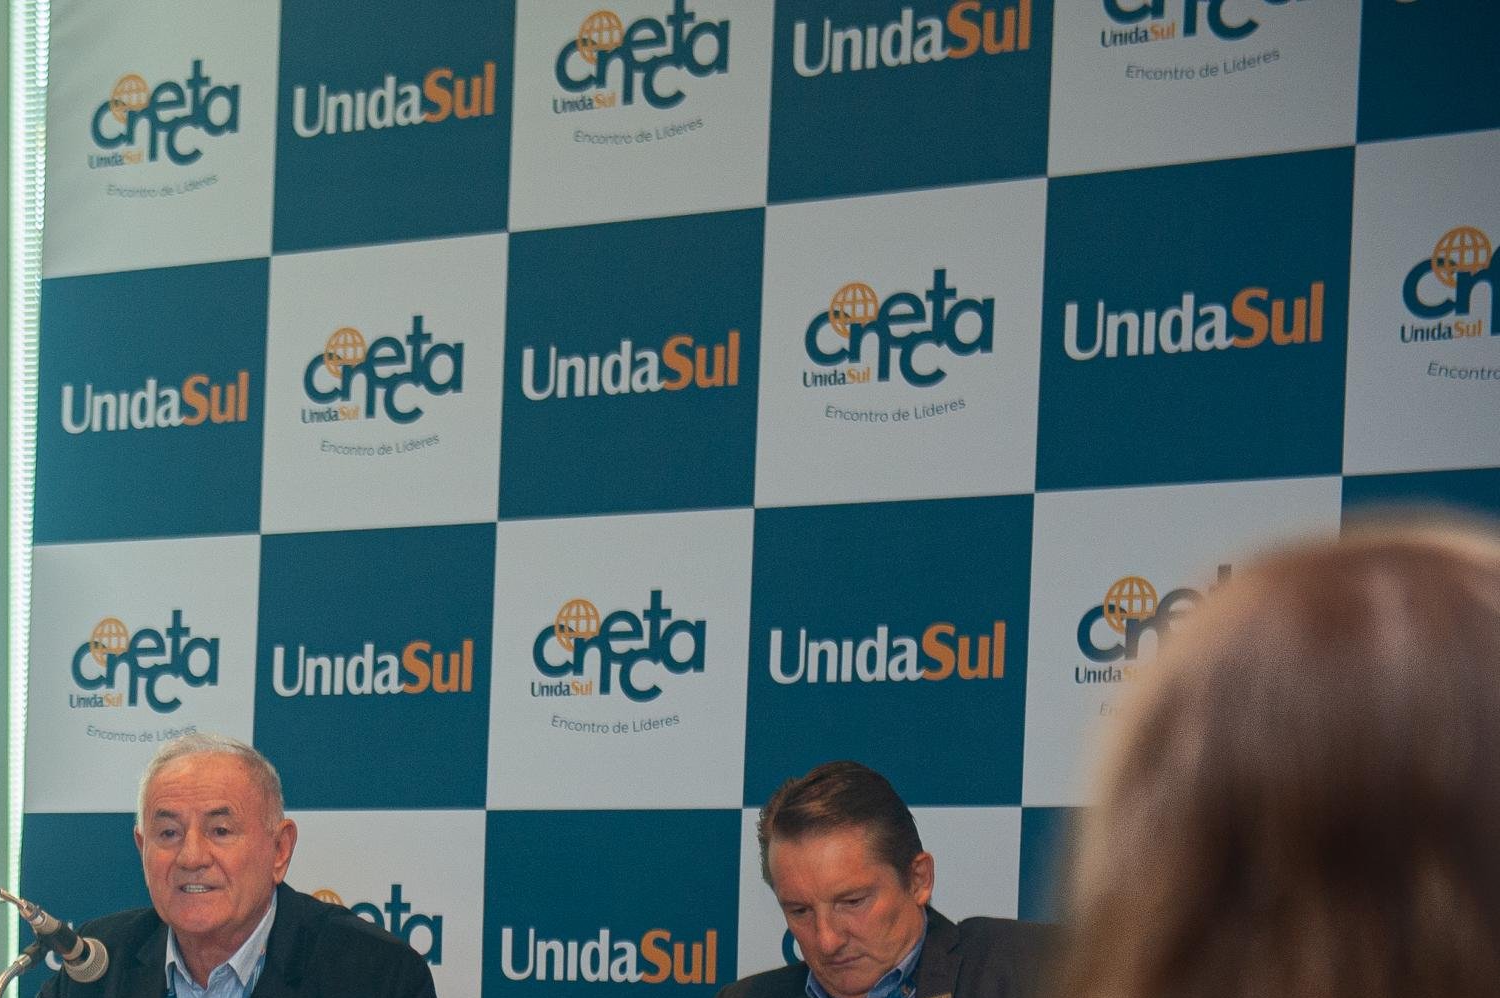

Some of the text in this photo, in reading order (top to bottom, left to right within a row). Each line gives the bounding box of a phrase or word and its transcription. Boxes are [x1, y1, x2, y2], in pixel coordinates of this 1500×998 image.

[793, 0, 1030, 77] UnidaSul
[1125, 49, 1280, 81] Encontro de Líderes
[293, 61, 494, 137] UnidaSul
[573, 130, 632, 145] Encontro
[635, 131, 652, 143] de
[1064, 281, 1323, 360] UnidaSul
[1401, 320, 1483, 343] UnidaSul
[522, 330, 739, 400] UnidaSul
[61, 370, 248, 433] UnidaSul
[825, 398, 966, 422] Encontro de Líderes
[320, 440, 375, 456] Encontro
[377, 443, 393, 455] de
[273, 638, 472, 696] UnidaSul
[769, 620, 1005, 684] UnidaSul
[86, 725, 136, 742] Encontro
[138, 731, 153, 742] de
[552, 714, 680, 734] Encontro de Líderes
[501, 927, 716, 983] UnidaSul
